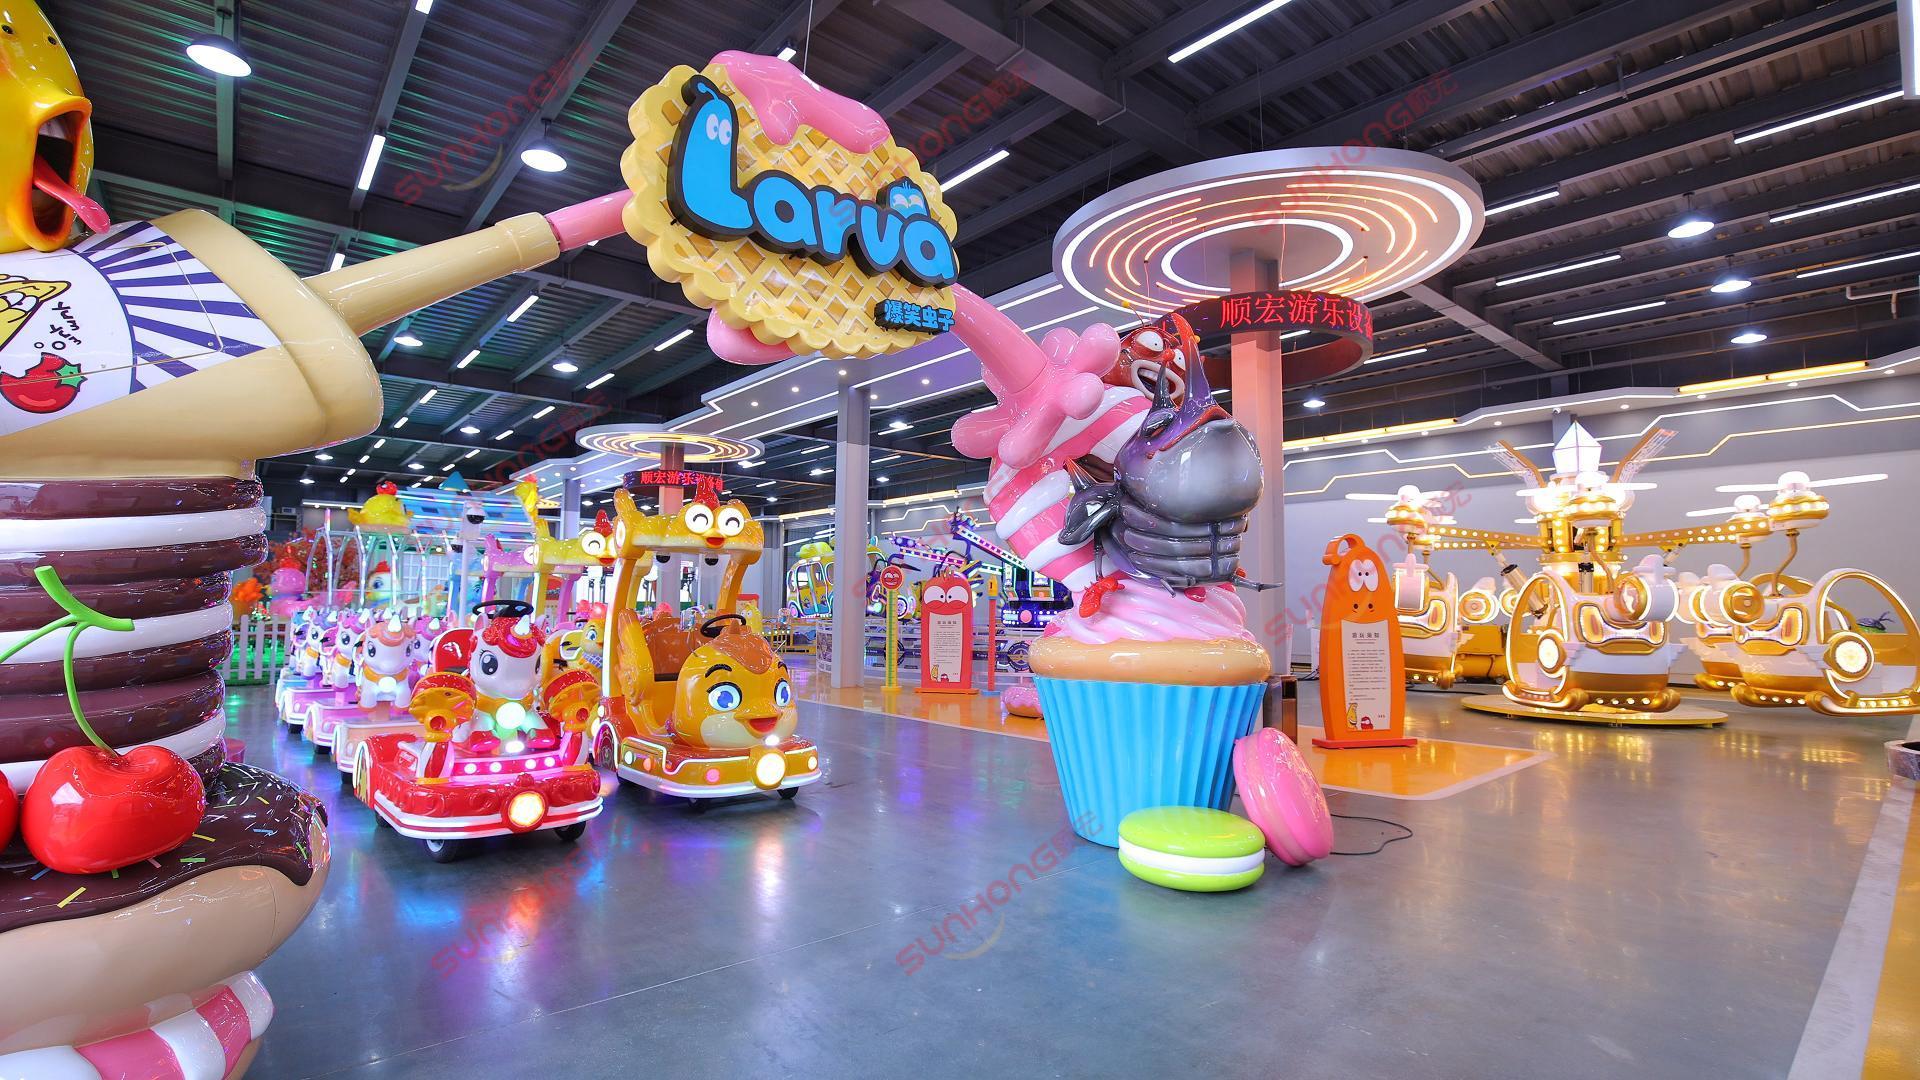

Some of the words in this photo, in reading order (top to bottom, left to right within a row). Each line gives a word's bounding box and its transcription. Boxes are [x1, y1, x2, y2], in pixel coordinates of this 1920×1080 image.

[680, 83, 957, 281] Larva
[884, 299, 956, 331] 爆笑虫子
